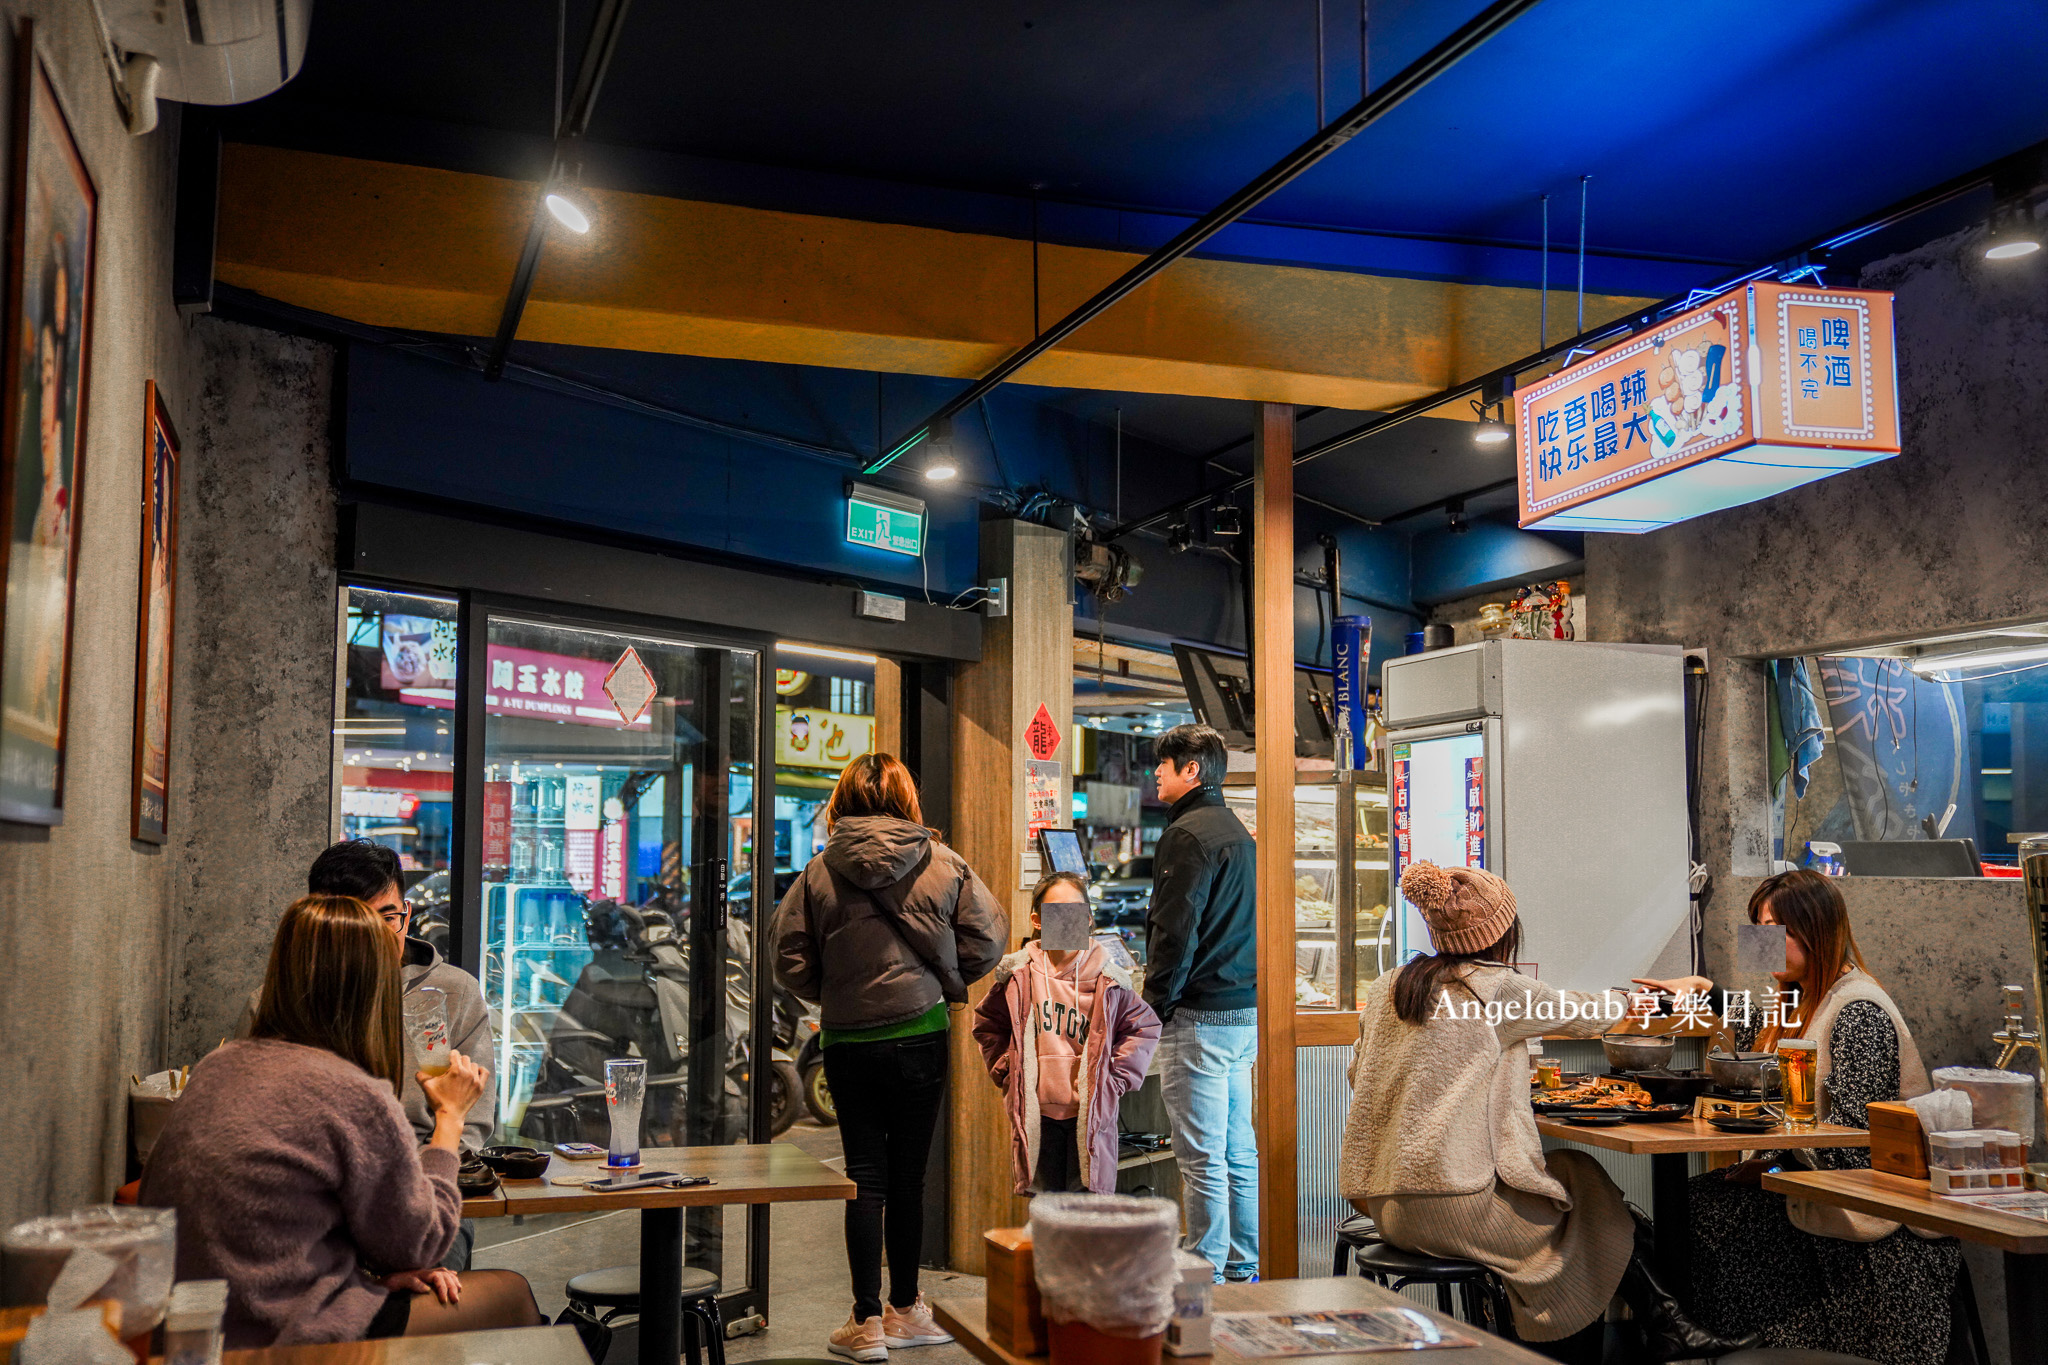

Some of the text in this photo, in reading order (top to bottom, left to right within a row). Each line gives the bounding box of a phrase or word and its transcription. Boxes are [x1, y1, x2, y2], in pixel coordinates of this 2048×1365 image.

[1798, 328, 1819, 399] 喝不完
[1821, 317, 1851, 386] 啤酒
[1537, 368, 1647, 446] 吃香喝辣
[1539, 412, 1648, 482] 快乐最大
[851, 526, 875, 541] EXIT
[1337, 643, 1350, 703] BLANC
[502, 697, 573, 715] A-YU DUMPLINGS
[1032, 717, 1047, 754] 龍
